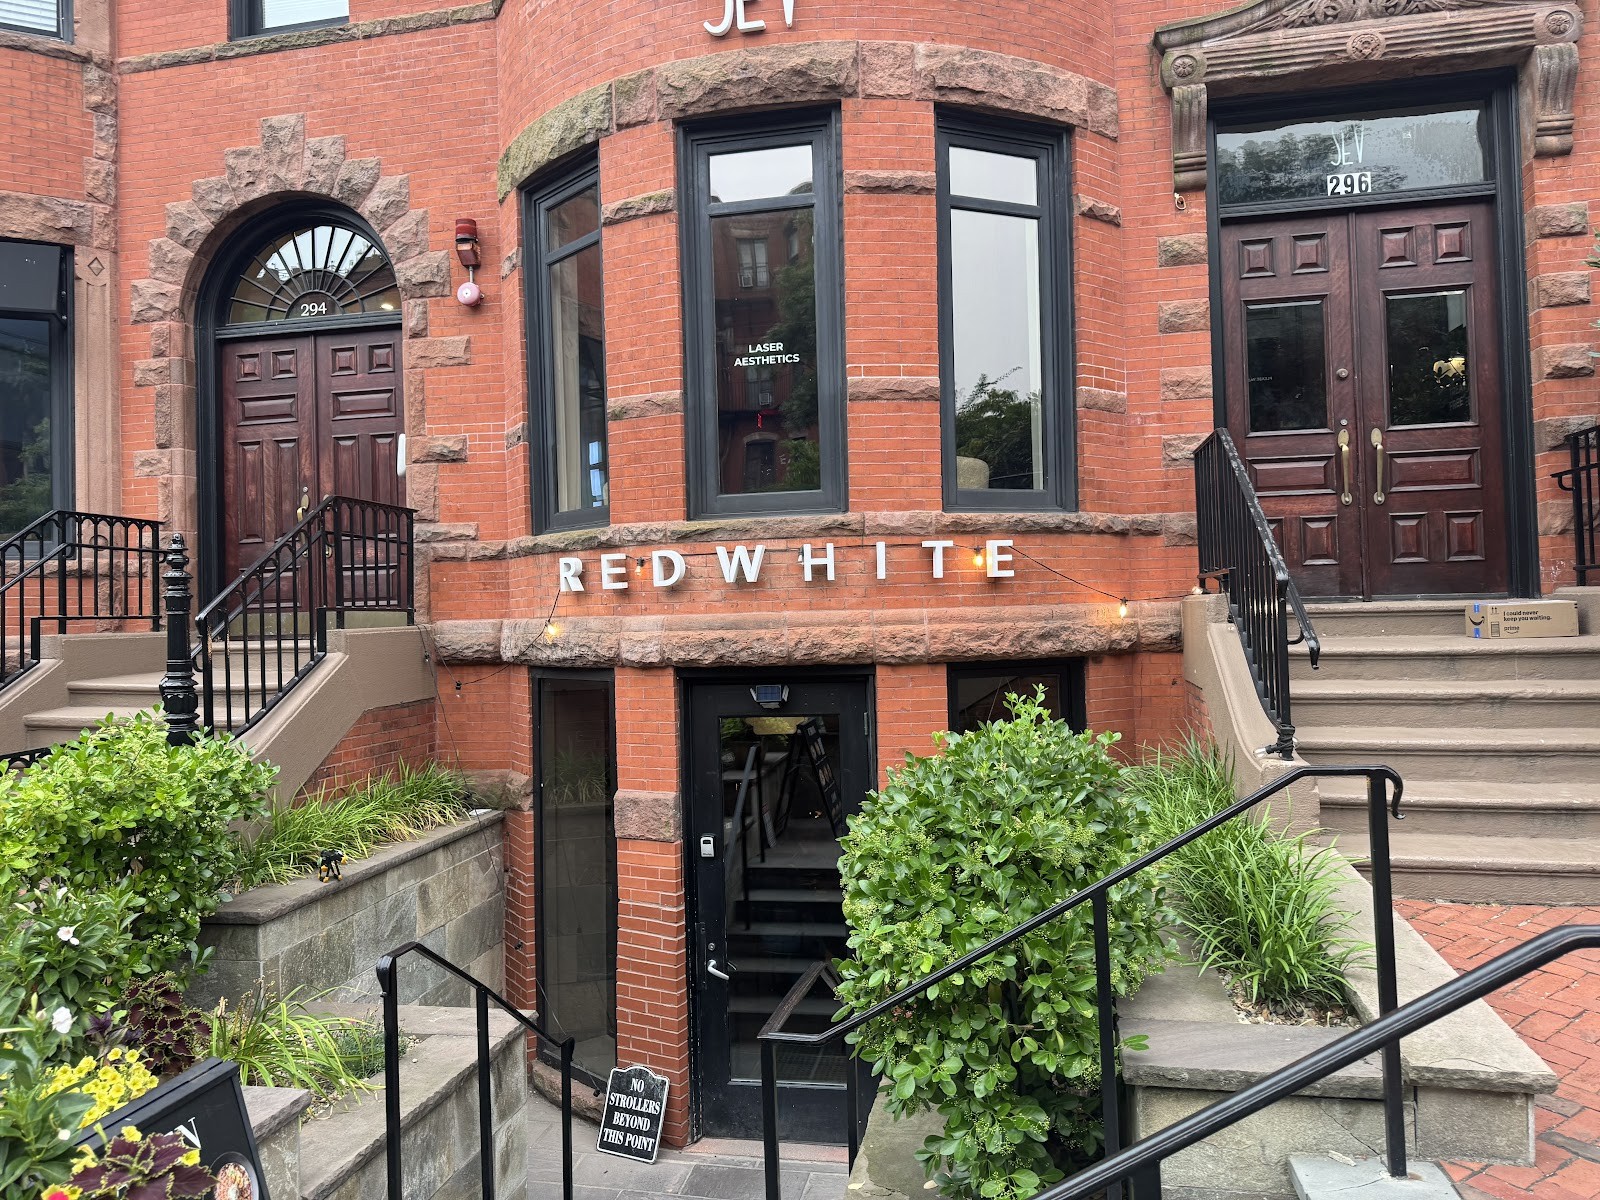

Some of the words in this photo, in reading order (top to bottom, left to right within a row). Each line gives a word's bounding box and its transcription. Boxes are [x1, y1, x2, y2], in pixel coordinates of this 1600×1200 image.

[1329, 173, 1369, 195] 296
[300, 301, 328, 317] 294
[748, 342, 784, 353] LASER
[733, 353, 800, 367] AESTHETICS
[630, 1078, 645, 1092] NO
[609, 1092, 661, 1115] STROLLERS
[612, 1111, 651, 1132] BEYOND
[603, 1128, 624, 1145] THIS
[625, 1133, 655, 1152] POINT
